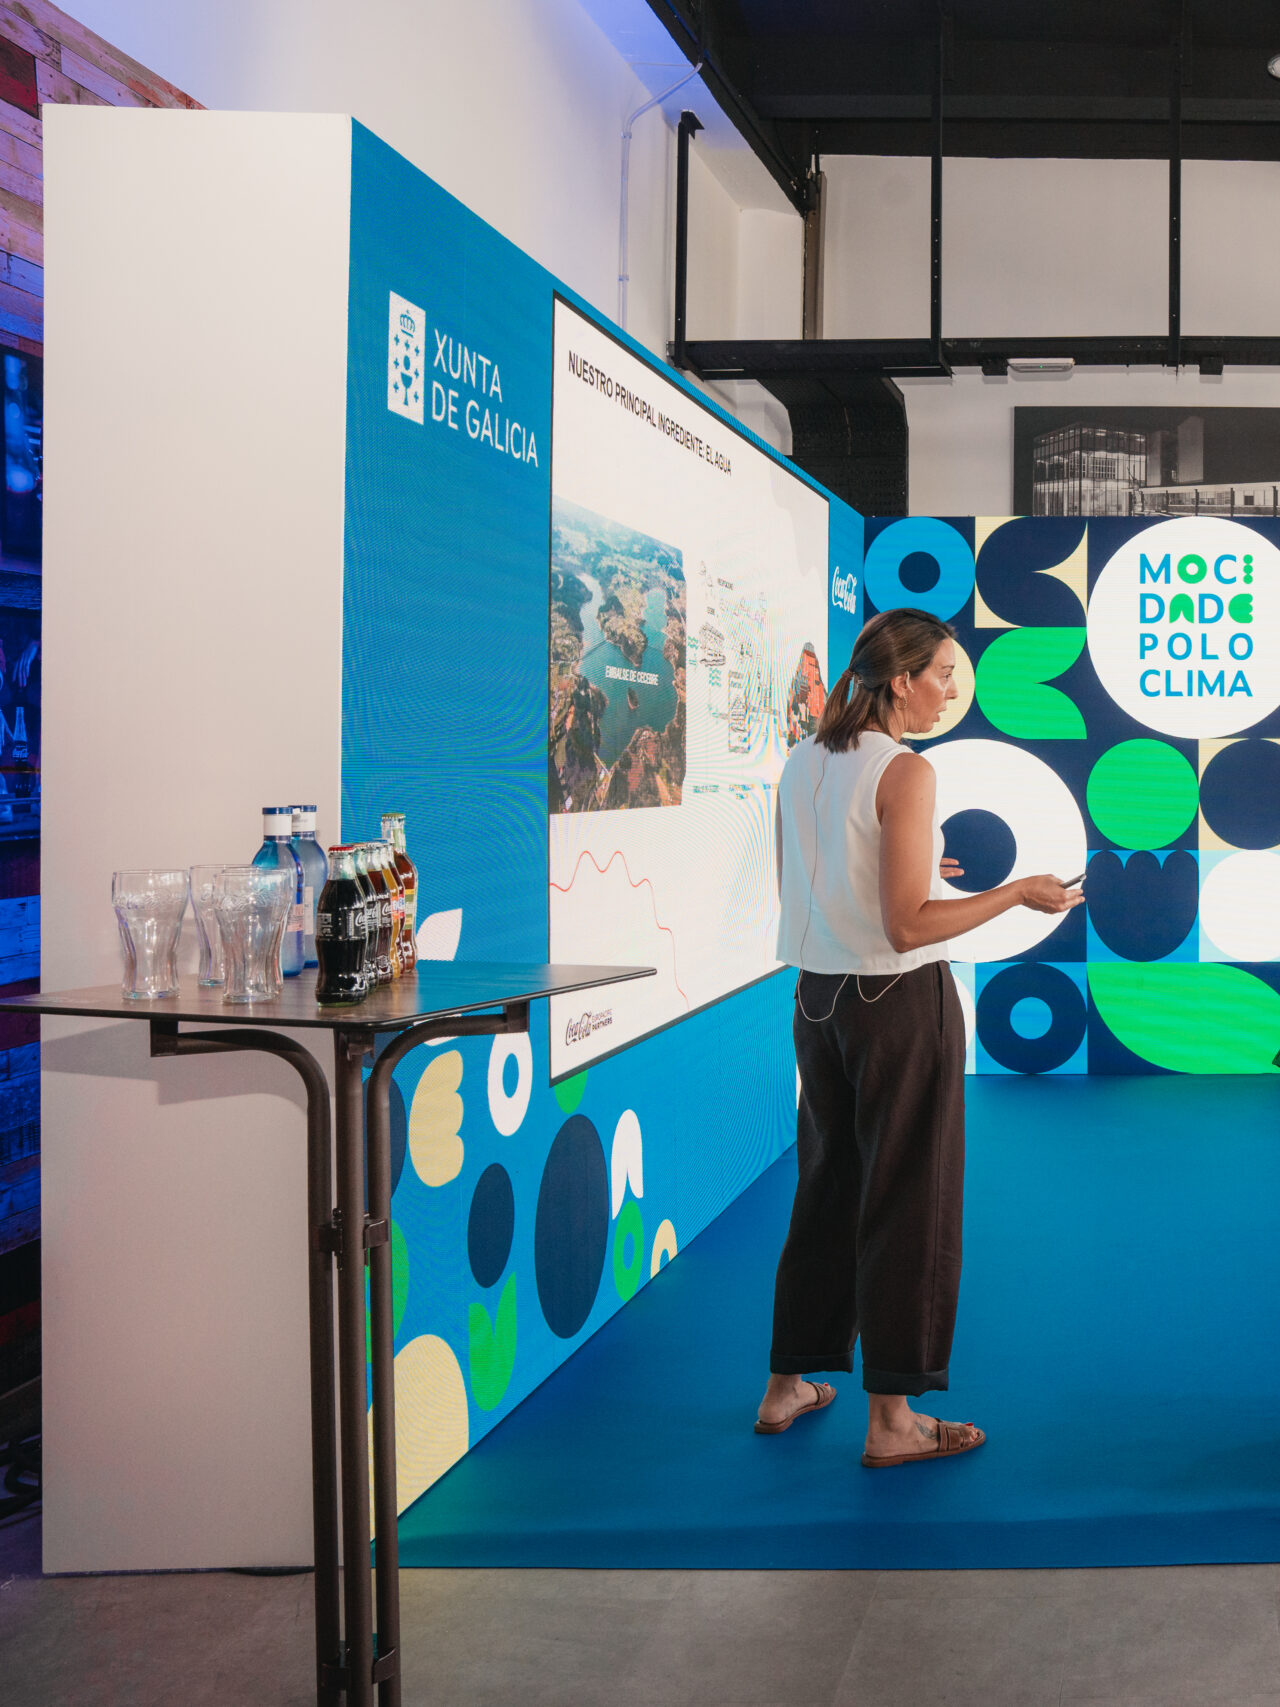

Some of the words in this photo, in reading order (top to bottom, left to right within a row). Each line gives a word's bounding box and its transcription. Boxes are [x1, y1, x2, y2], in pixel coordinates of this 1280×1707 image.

[433, 328, 503, 403] XUNTA
[432, 380, 459, 431] DE
[465, 399, 538, 468] GALICIA
[568, 350, 613, 398] NUESTRO
[615, 382, 656, 428] PRINCIPAL
[706, 444, 714, 465] EL
[715, 451, 732, 476] AGUA
[1139, 593, 1253, 624] DADE
[1139, 632, 1254, 660] POLO
[1139, 669, 1253, 697] CLIMA
